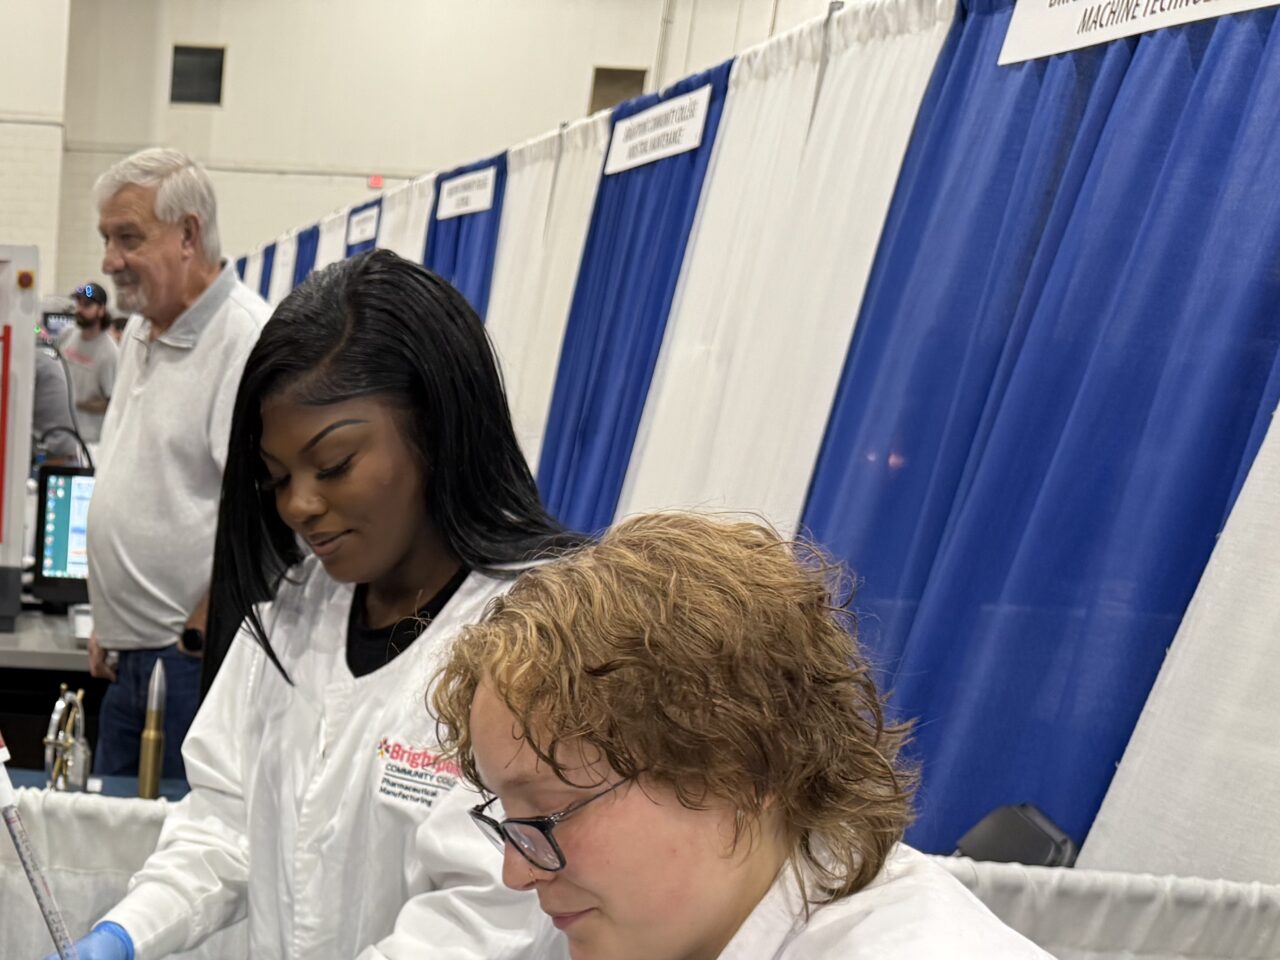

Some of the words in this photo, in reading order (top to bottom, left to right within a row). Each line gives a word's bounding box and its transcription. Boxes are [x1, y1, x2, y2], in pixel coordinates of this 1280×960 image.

[1077, 0, 1139, 34] MACHINE
[385, 763, 434, 781] COMMUNITY
[379, 786, 433, 807] Manufacturing
[381, 778, 438, 797] Pharmaceutical
